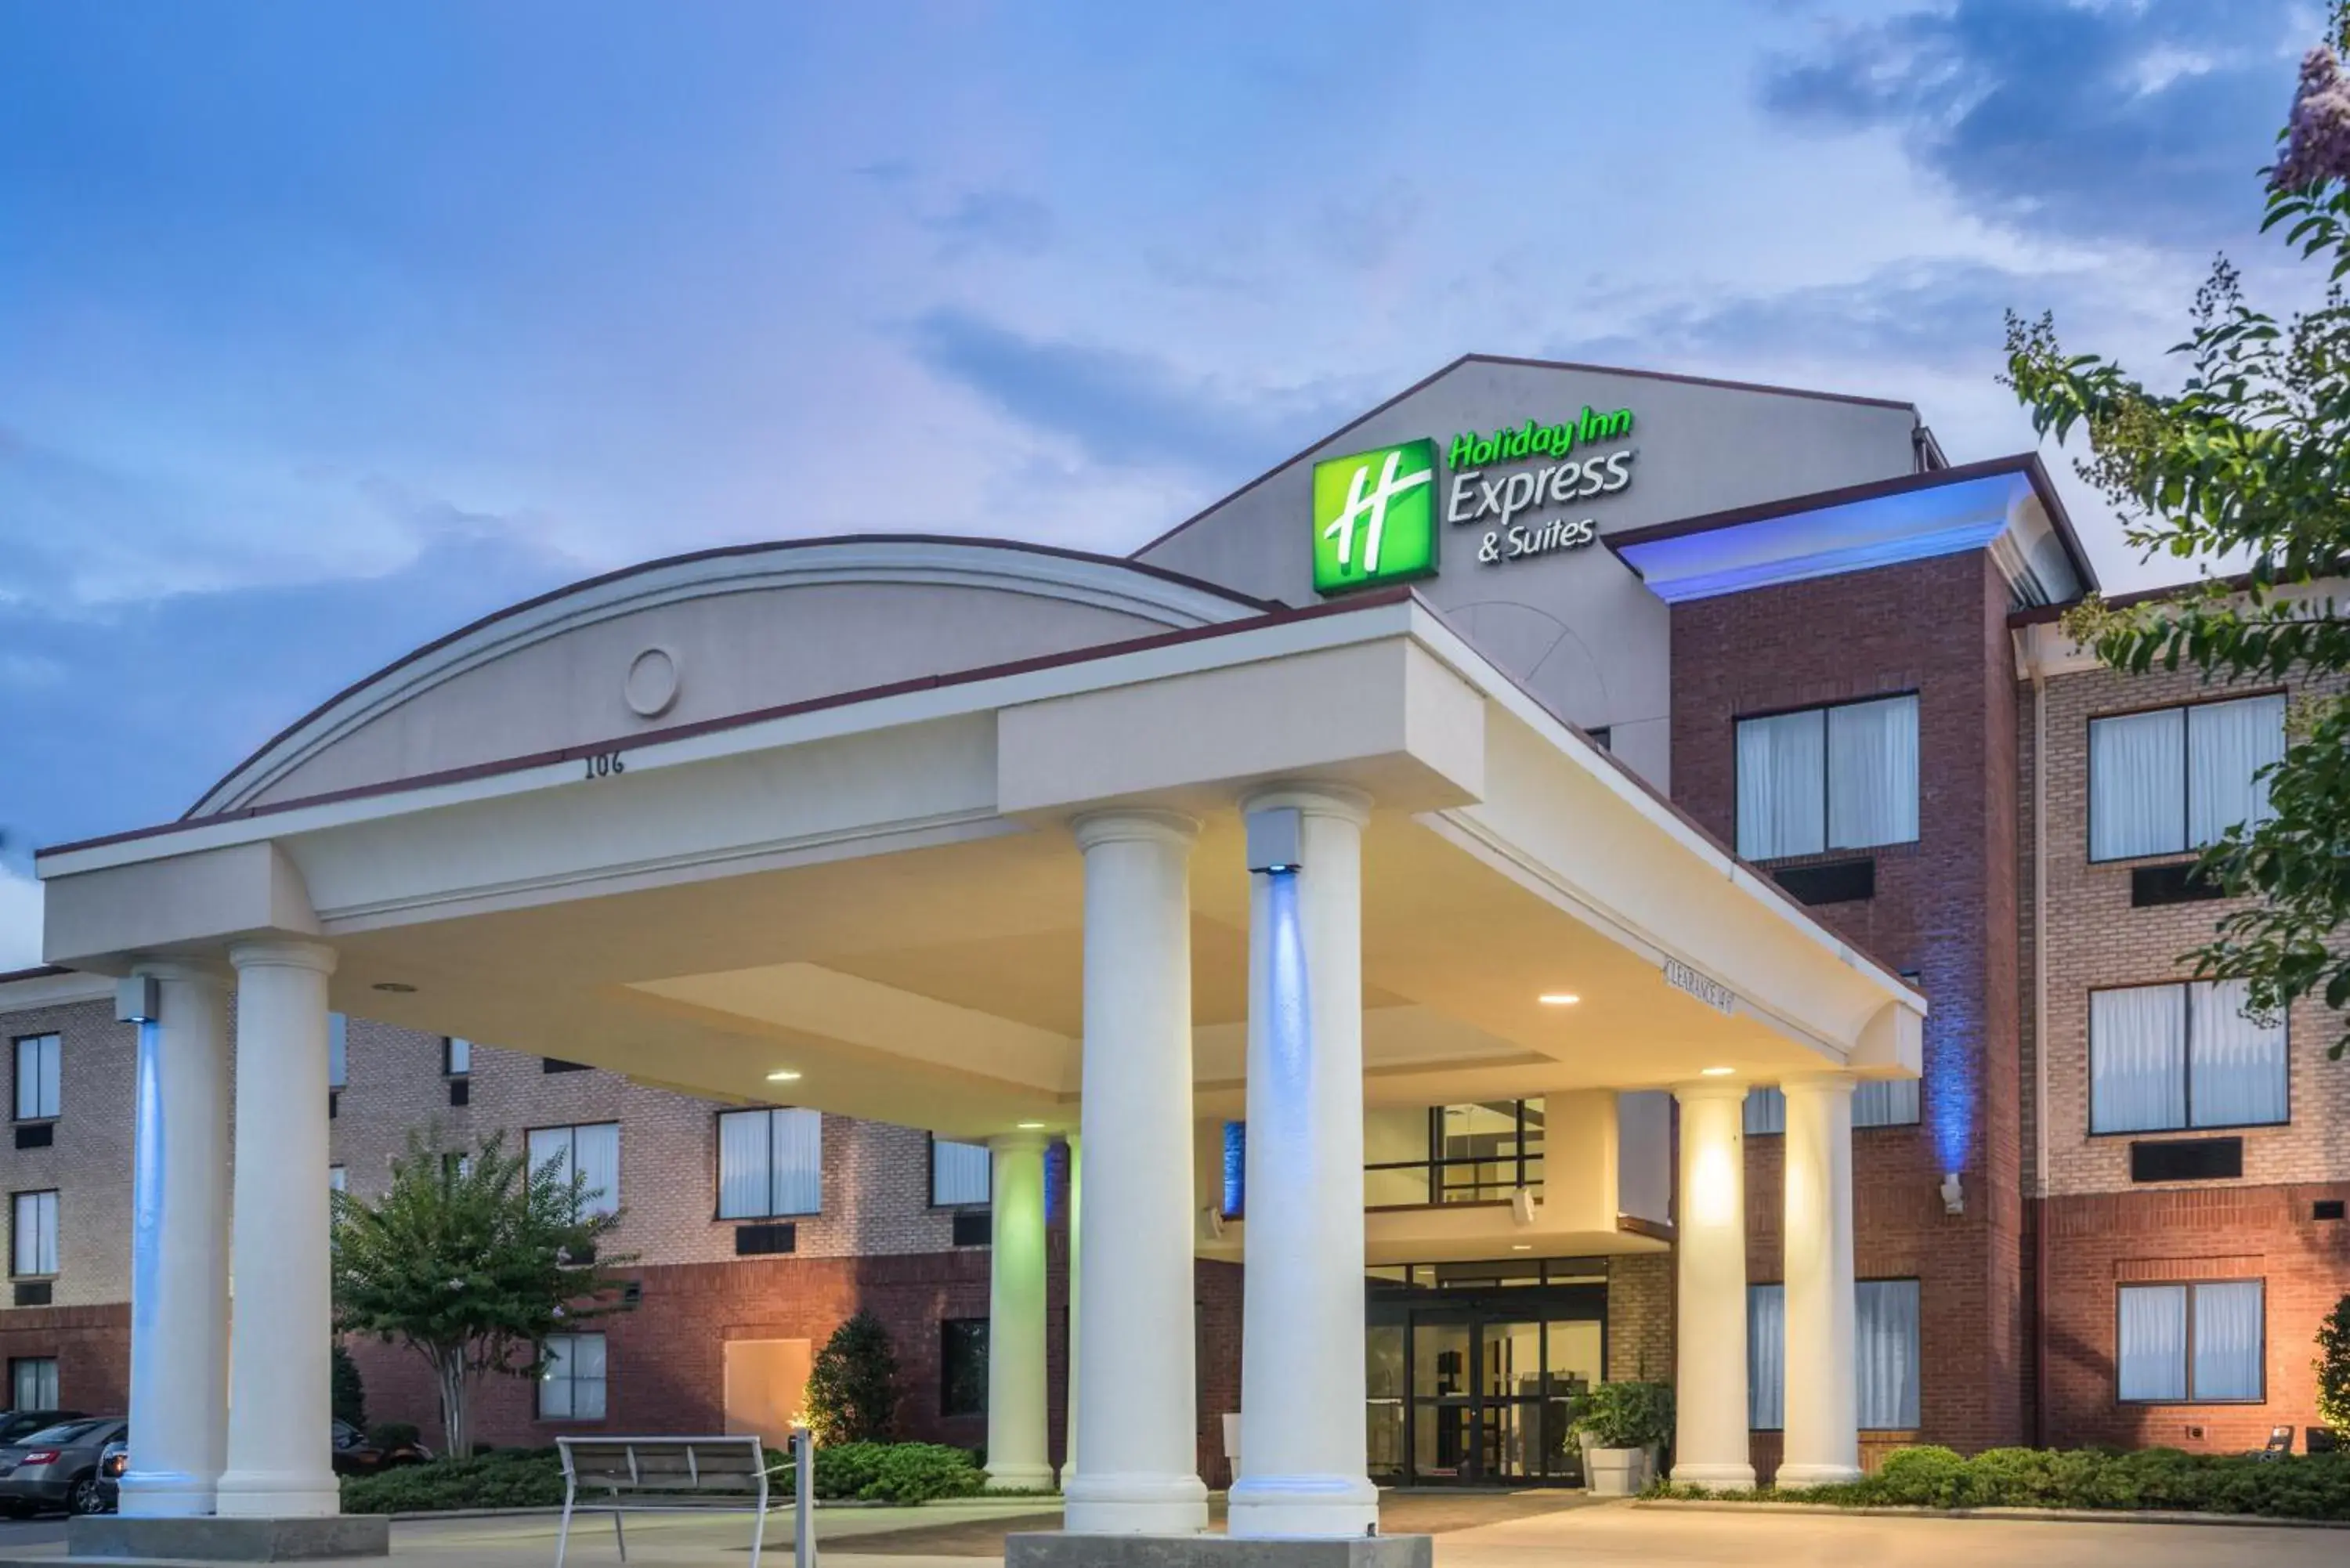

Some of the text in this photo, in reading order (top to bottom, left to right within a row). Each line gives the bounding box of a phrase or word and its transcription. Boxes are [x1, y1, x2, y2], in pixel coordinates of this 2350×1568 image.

[1448, 405, 1632, 471] Holiday Inn
[1448, 450, 1630, 526] Express
[1478, 518, 1594, 562] & Suites
[584, 750, 624, 779] 106
